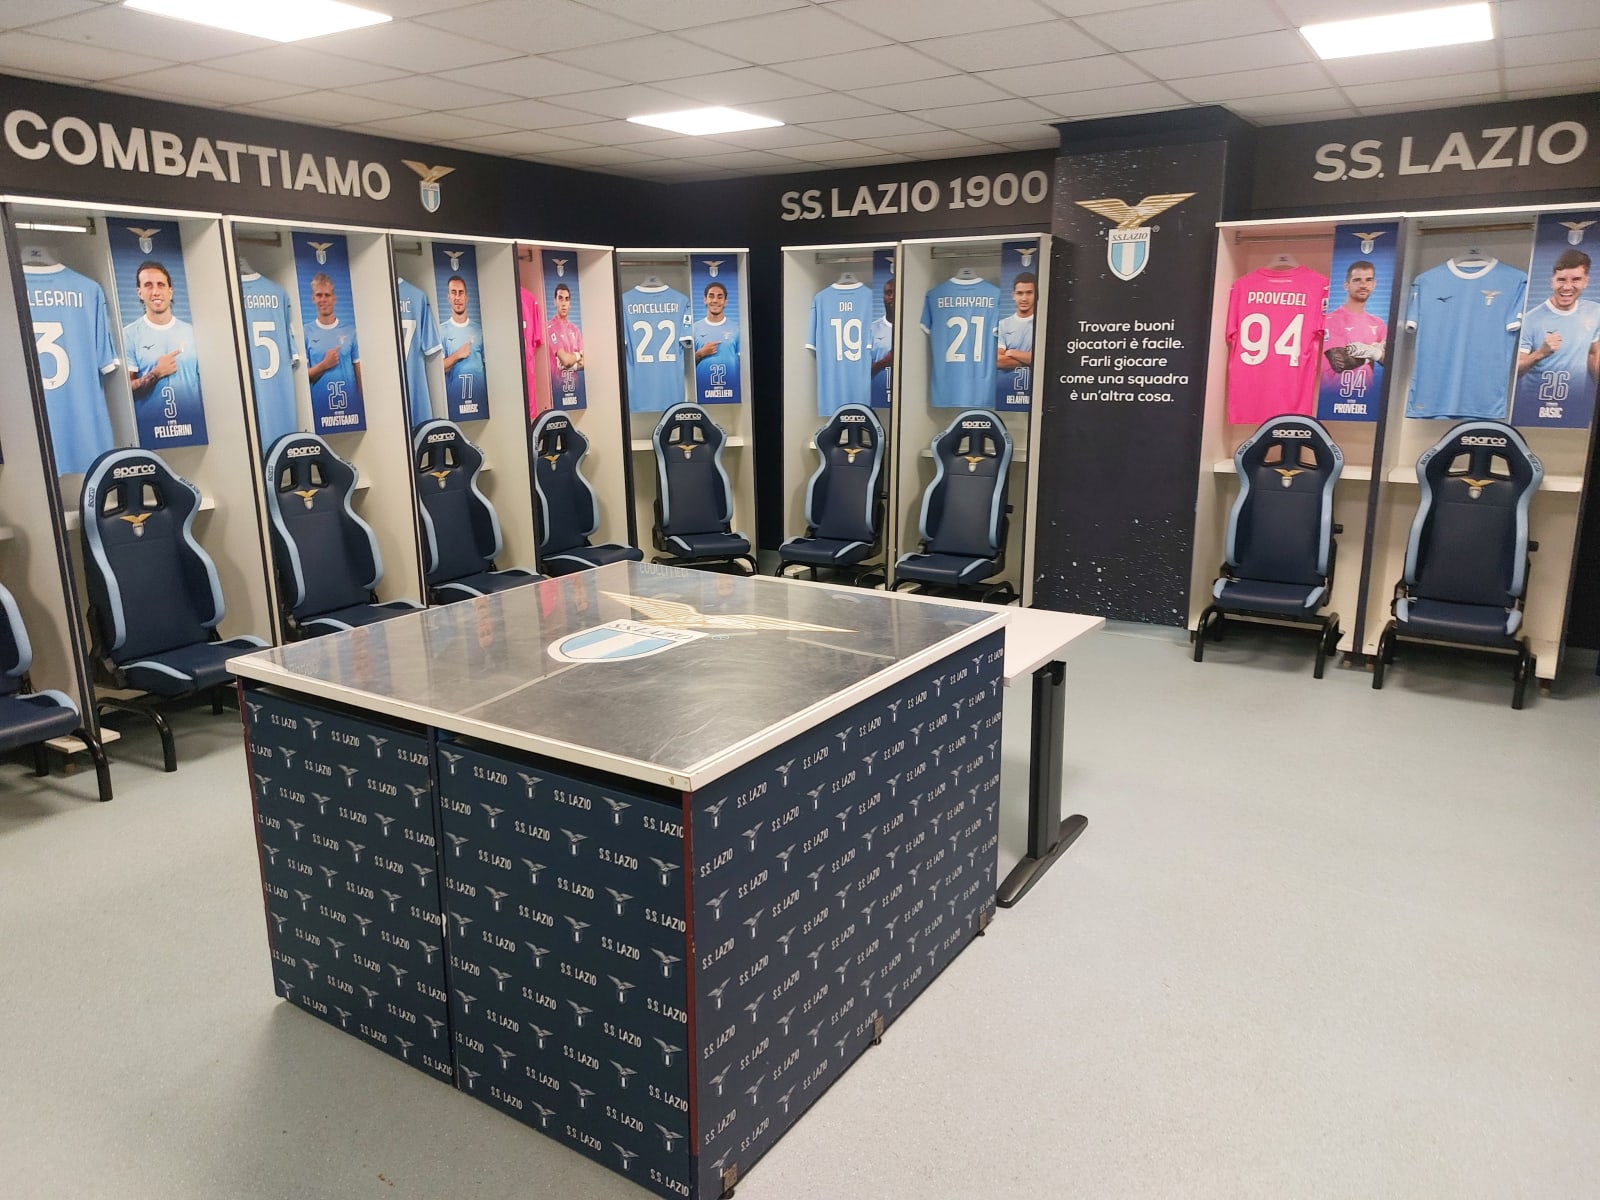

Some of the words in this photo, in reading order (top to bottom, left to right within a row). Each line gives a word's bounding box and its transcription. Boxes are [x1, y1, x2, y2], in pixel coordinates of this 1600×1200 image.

[4, 109, 391, 200] COMBATTIAMO
[1313, 139, 1384, 182] S.S.
[1398, 120, 1588, 175] LAZIO
[781, 190, 826, 221] S.S.
[832, 180, 940, 217] LAZIO
[949, 170, 1048, 209] 1900
[628, 303, 678, 315] CANCELLIERI
[839, 302, 853, 313] DIA
[937, 297, 994, 309] BELAHYANE
[1247, 291, 1307, 307] PROVEDEL
[1078, 321, 1131, 332] Trovare
[1134, 319, 1175, 332] buoni
[252, 321, 280, 380] 5
[402, 319, 417, 360] 7
[632, 320, 677, 363] 22
[830, 318, 862, 361] 19
[945, 316, 985, 363] 21
[1067, 338, 1126, 353] giocatori
[1130, 338, 1138, 349] è
[1142, 337, 1185, 349] facile.
[1239, 312, 1305, 367] 94
[32, 321, 70, 390] 3
[1080, 355, 1111, 367] Farli
[1114, 355, 1168, 370] giocare
[458, 373, 474, 399] 77
[710, 363, 727, 386] 22
[1013, 366, 1030, 391] 21
[1060, 374, 1095, 384] come
[1098, 374, 1124, 384] una
[1127, 373, 1189, 387] squadra
[1340, 369, 1367, 398] 94
[1538, 370, 1570, 401] 26
[161, 386, 177, 418] 3
[327, 381, 348, 409] 25
[1070, 389, 1079, 400] è
[1081, 389, 1134, 401] un'altra
[1138, 392, 1174, 401] cosa.
[1333, 403, 1368, 415] PROVEDEL
[154, 423, 193, 438] PELLEGRINI
[962, 420, 991, 429] sparco
[1272, 429, 1312, 438] sparco
[1460, 435, 1507, 447] sparco
[409, 751, 430, 766] LAZIO
[813, 746, 828, 764] LAZIO
[473, 765, 485, 779] S.S.
[486, 769, 508, 785] LAZIO
[841, 770, 856, 788] LAZIO
[378, 782, 397, 796] LAZIO
[554, 789, 568, 804] S.S.
[568, 793, 591, 811] LAZIO
[749, 781, 767, 802] LAZIO
[783, 805, 799, 825] LAZIO
[416, 831, 435, 847] LAZIO
[514, 820, 528, 835] S.S.
[528, 824, 550, 841] LAZIO
[813, 827, 829, 847] LAZIO
[385, 859, 404, 874] LAZIO
[478, 849, 491, 863] S.S.
[491, 854, 512, 870] LAZIO
[598, 847, 613, 863] S.S.
[614, 852, 638, 870] LAZIO
[713, 847, 733, 870] LAZIO
[557, 877, 571, 892] S.S.
[572, 882, 594, 900] LAZIO
[750, 869, 768, 891] LAZIO
[356, 885, 374, 900] LAZIO
[783, 889, 800, 910] LAZIO
[330, 909, 346, 924] LAZIO
[518, 904, 531, 919] S.S.
[532, 909, 553, 927] LAZIO
[645, 908, 660, 924] S.S.
[661, 913, 686, 933] LAZIO
[813, 907, 828, 927] LAZIO
[392, 935, 410, 950] LAZIO
[482, 930, 495, 945] S.S.
[495, 935, 516, 953] LAZIO
[601, 936, 615, 952] S.S.
[616, 941, 640, 960] LAZIO
[715, 937, 734, 961] LAZIO
[560, 962, 574, 977] S.S.
[574, 967, 597, 986] LAZIO
[751, 954, 769, 977] LAZIO
[428, 986, 447, 1002] LAZIO
[522, 986, 535, 1001] S.S.
[535, 992, 557, 1010] LAZIO
[398, 1008, 416, 1024] LAZIO
[486, 1009, 499, 1024] S.S.
[499, 1015, 519, 1032] LAZIO
[647, 997, 661, 1014] S.S.
[663, 1004, 687, 1024] LAZIO
[603, 1022, 617, 1038] S.S.
[618, 1028, 642, 1048] LAZIO
[716, 1024, 735, 1049] LAZIO
[563, 1045, 577, 1060] S.S.
[577, 1051, 599, 1070] LAZIO
[752, 1037, 769, 1060] LAZIO
[525, 1066, 538, 1081] S.S.
[539, 1072, 560, 1091] LAZIO
[490, 1086, 503, 1100] S.S.
[503, 1091, 523, 1110] LAZIO
[648, 1084, 663, 1101] S.S.
[664, 1091, 688, 1112] LAZIO
[606, 1105, 619, 1121] S.S.
[621, 1112, 643, 1132] LAZIO
[717, 1109, 736, 1134] LAZIO
[566, 1124, 579, 1140] S.S.
[580, 1131, 601, 1151] LAZIO
[650, 1168, 664, 1185] S.S.
[666, 1176, 689, 1197] LAZIO
